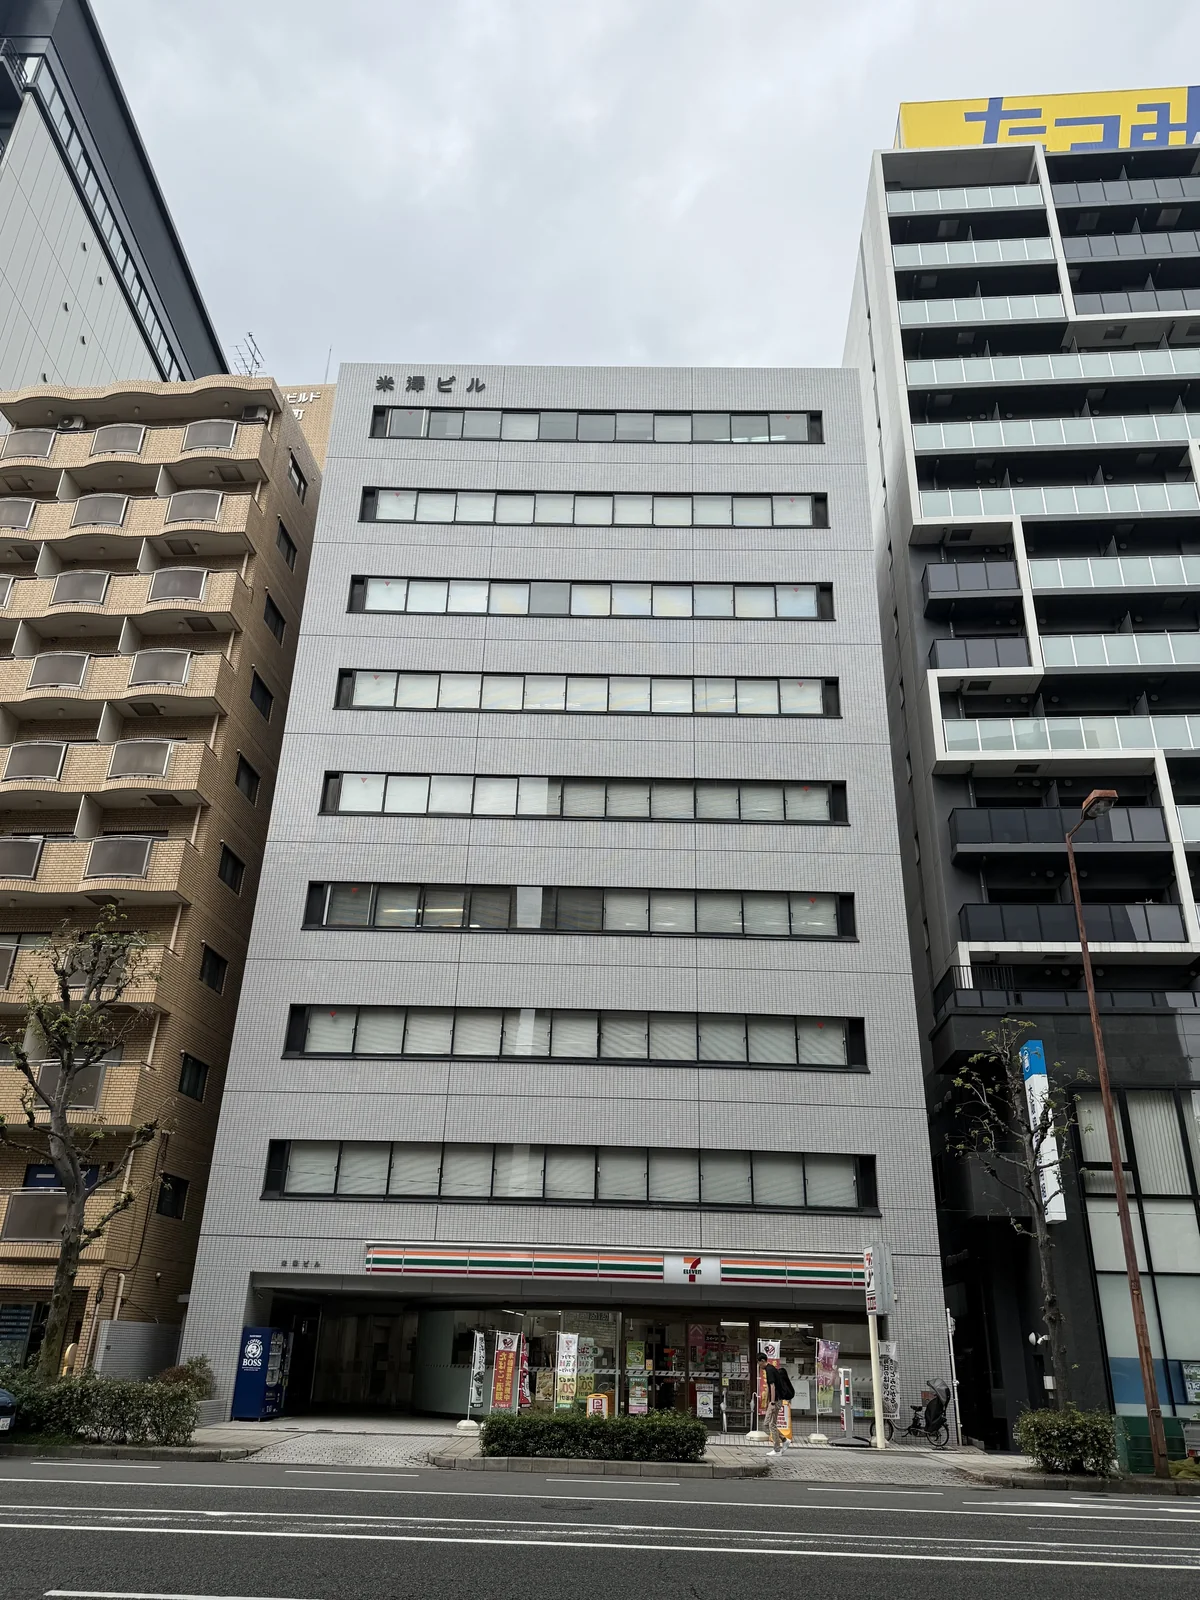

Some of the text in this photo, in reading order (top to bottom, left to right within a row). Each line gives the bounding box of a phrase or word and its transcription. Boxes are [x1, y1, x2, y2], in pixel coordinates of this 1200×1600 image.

[282, 391, 321, 404] ビルド
[242, 1358, 262, 1367] BOSS
